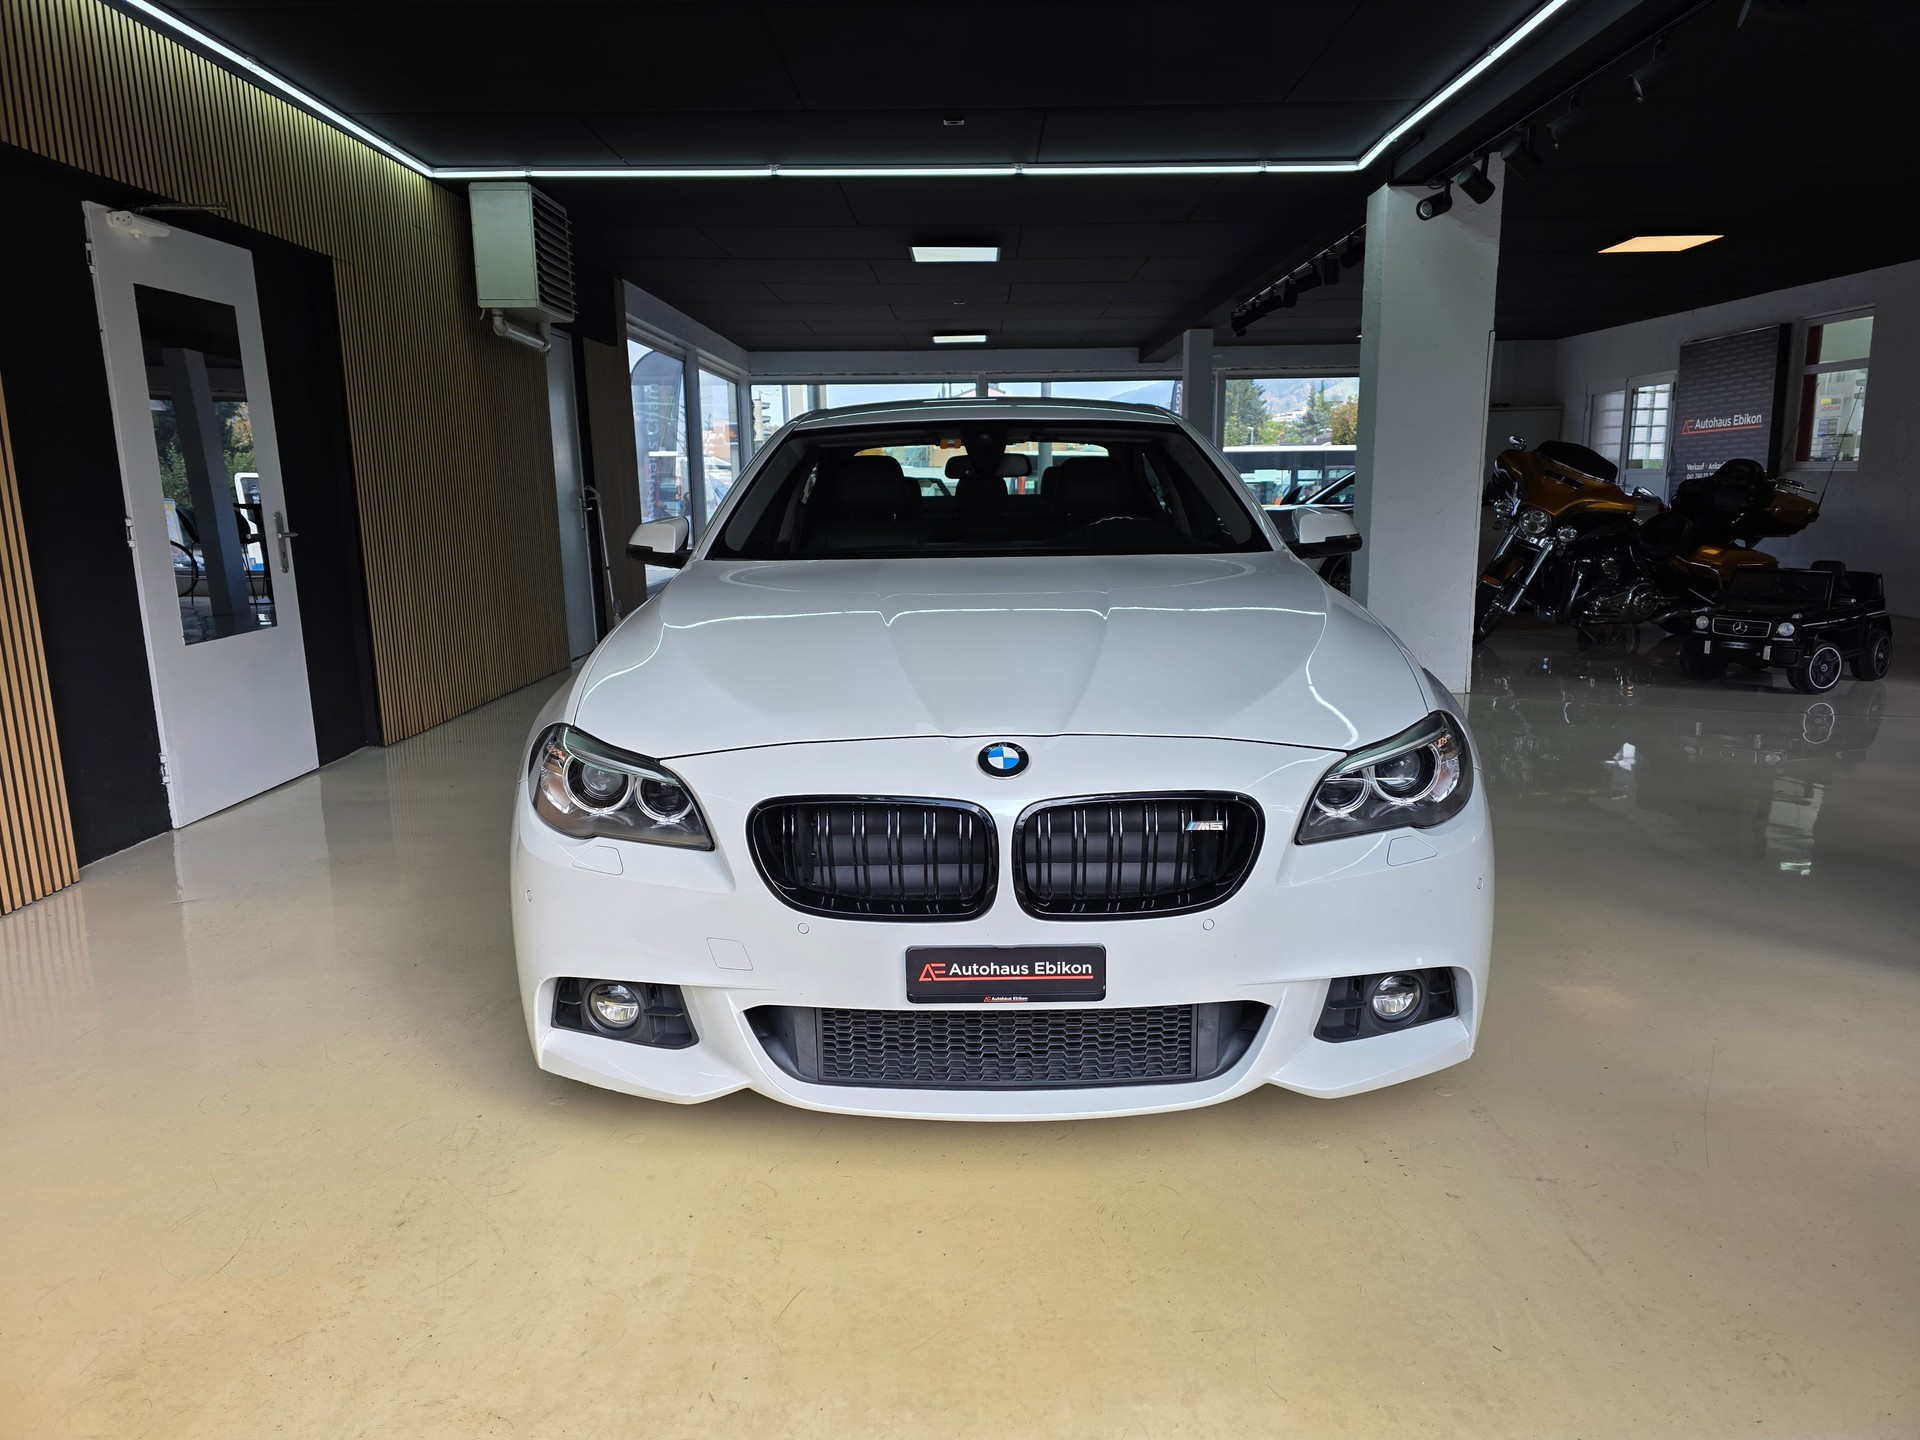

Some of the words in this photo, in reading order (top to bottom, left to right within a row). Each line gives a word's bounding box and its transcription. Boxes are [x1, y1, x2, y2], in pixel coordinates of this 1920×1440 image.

[1694, 417, 1732, 429] Autohaus
[1733, 413, 1762, 426] Ebikon
[1686, 462, 1705, 471] Verkauf
[949, 962, 1030, 976] Autohaus
[1034, 961, 1093, 975] Ebikon
